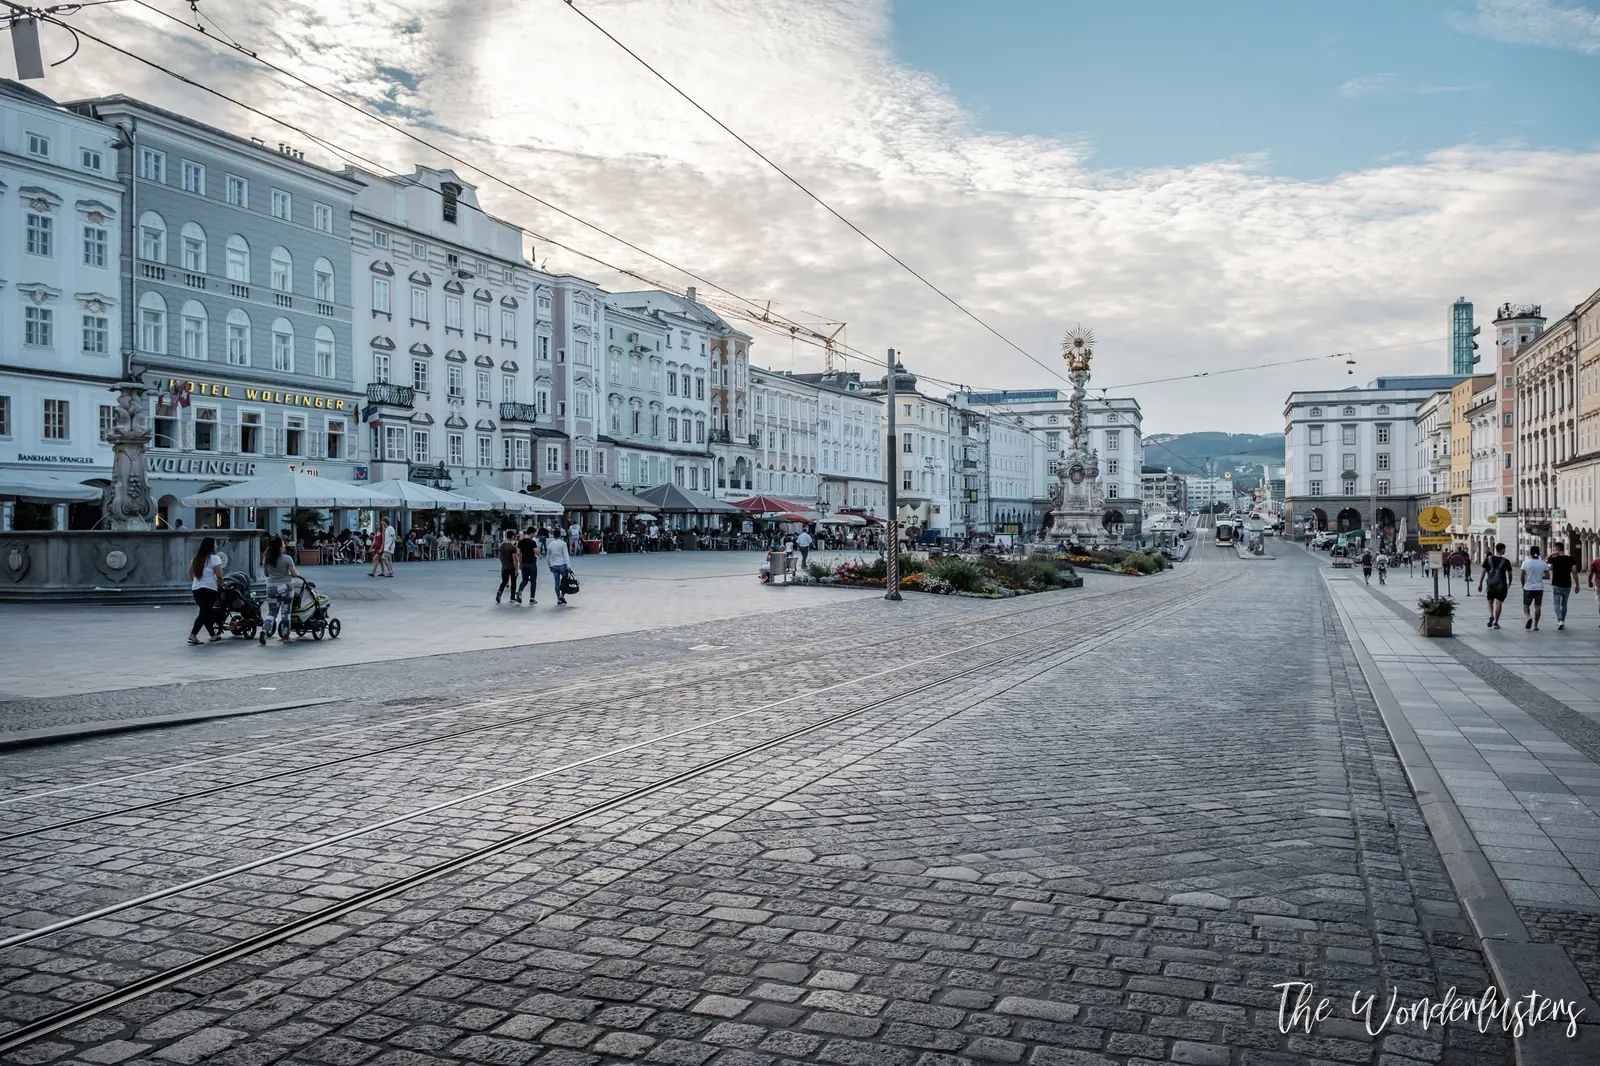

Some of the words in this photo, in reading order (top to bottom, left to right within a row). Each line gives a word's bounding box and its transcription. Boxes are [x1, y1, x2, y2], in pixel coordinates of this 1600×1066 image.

[246, 388, 344, 409] WOLFINGER
[18, 453, 57, 462] BANKHAUS
[59, 455, 94, 464] SPANGLER
[146, 458, 256, 475] WOLFINGER
